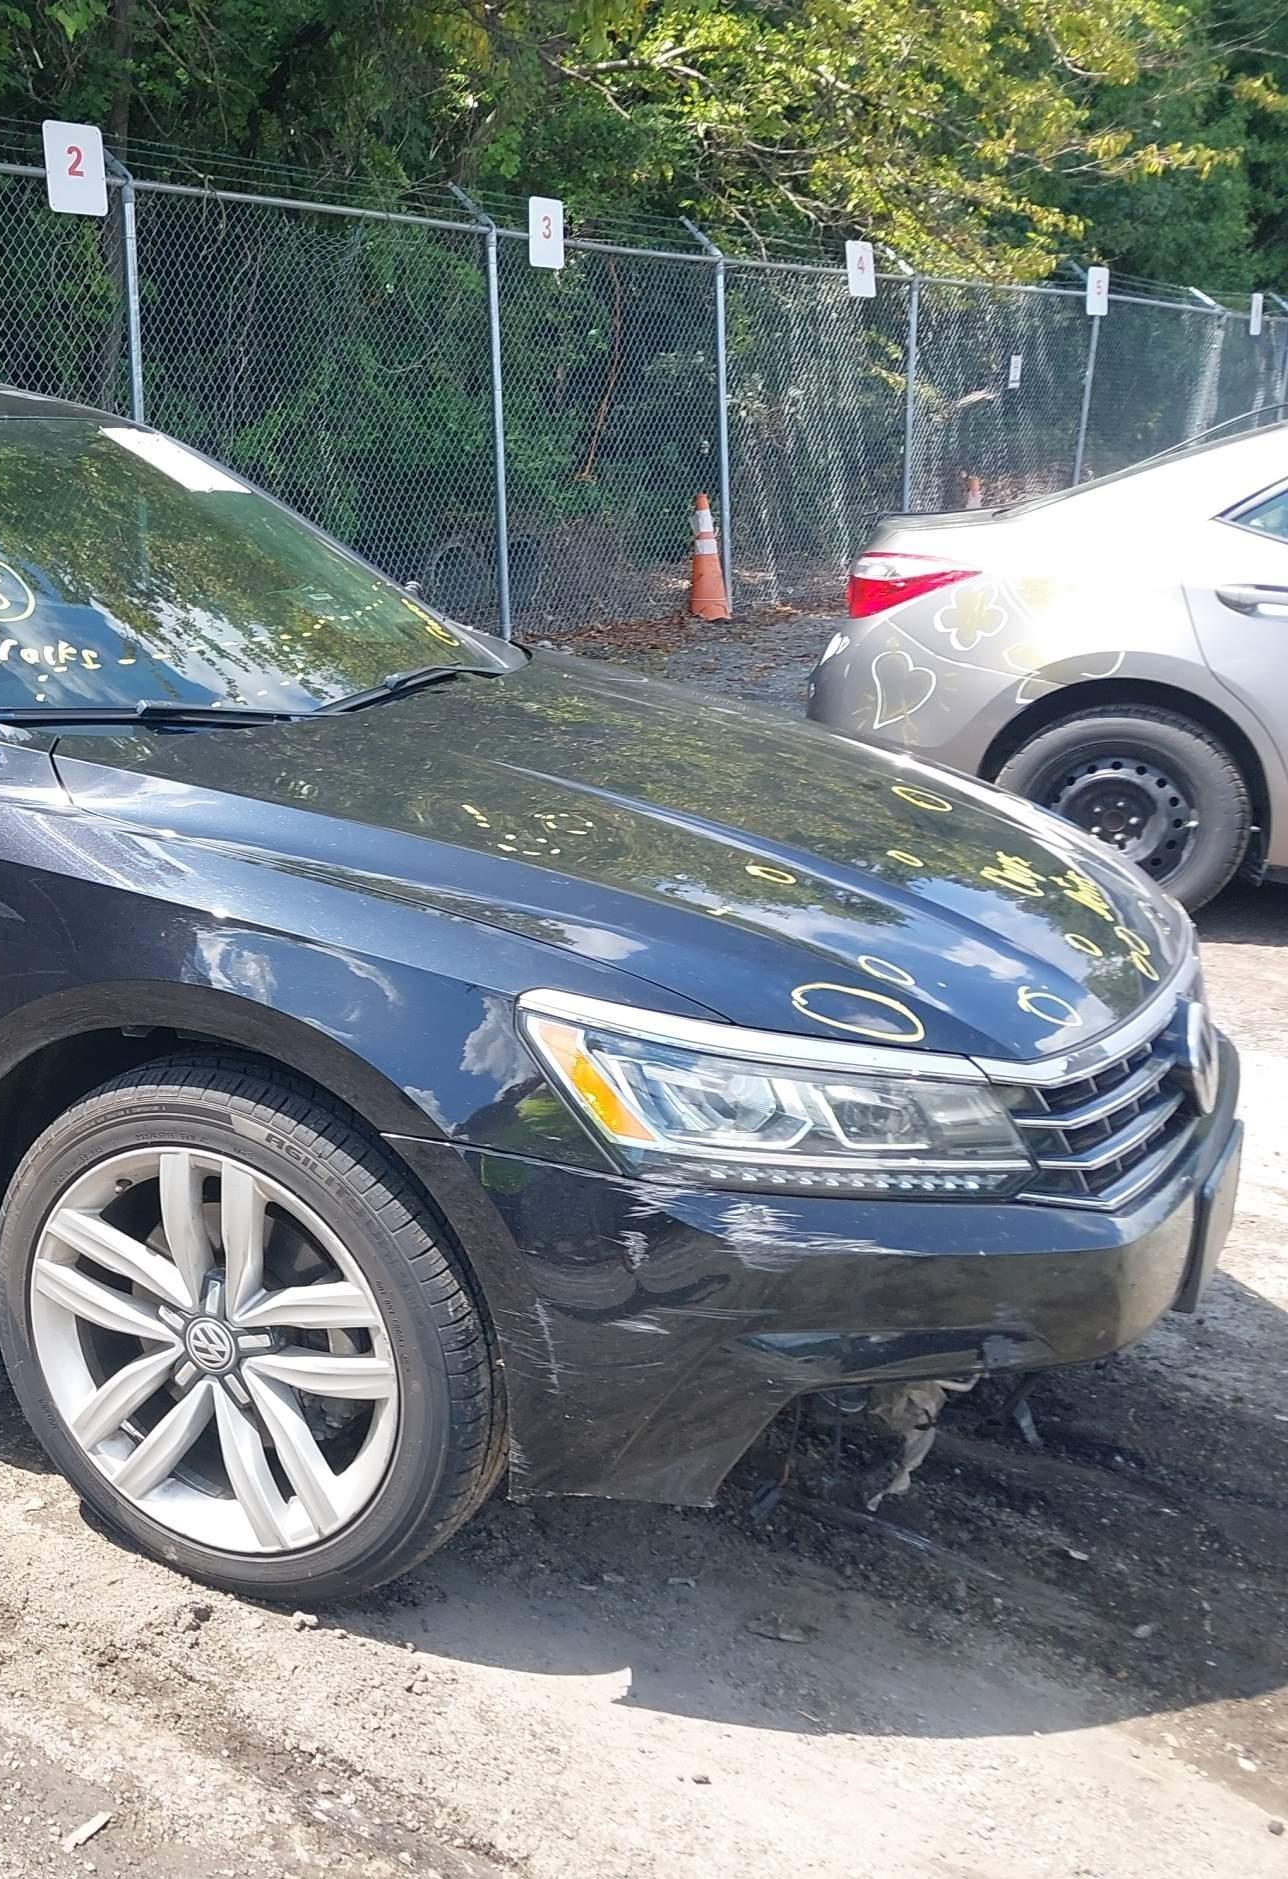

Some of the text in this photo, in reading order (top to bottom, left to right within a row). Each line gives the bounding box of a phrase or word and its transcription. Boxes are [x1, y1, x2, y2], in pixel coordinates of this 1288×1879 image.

[67, 146, 84, 177] 2
[542, 215, 552, 240] 3
[857, 255, 865, 275] 4
